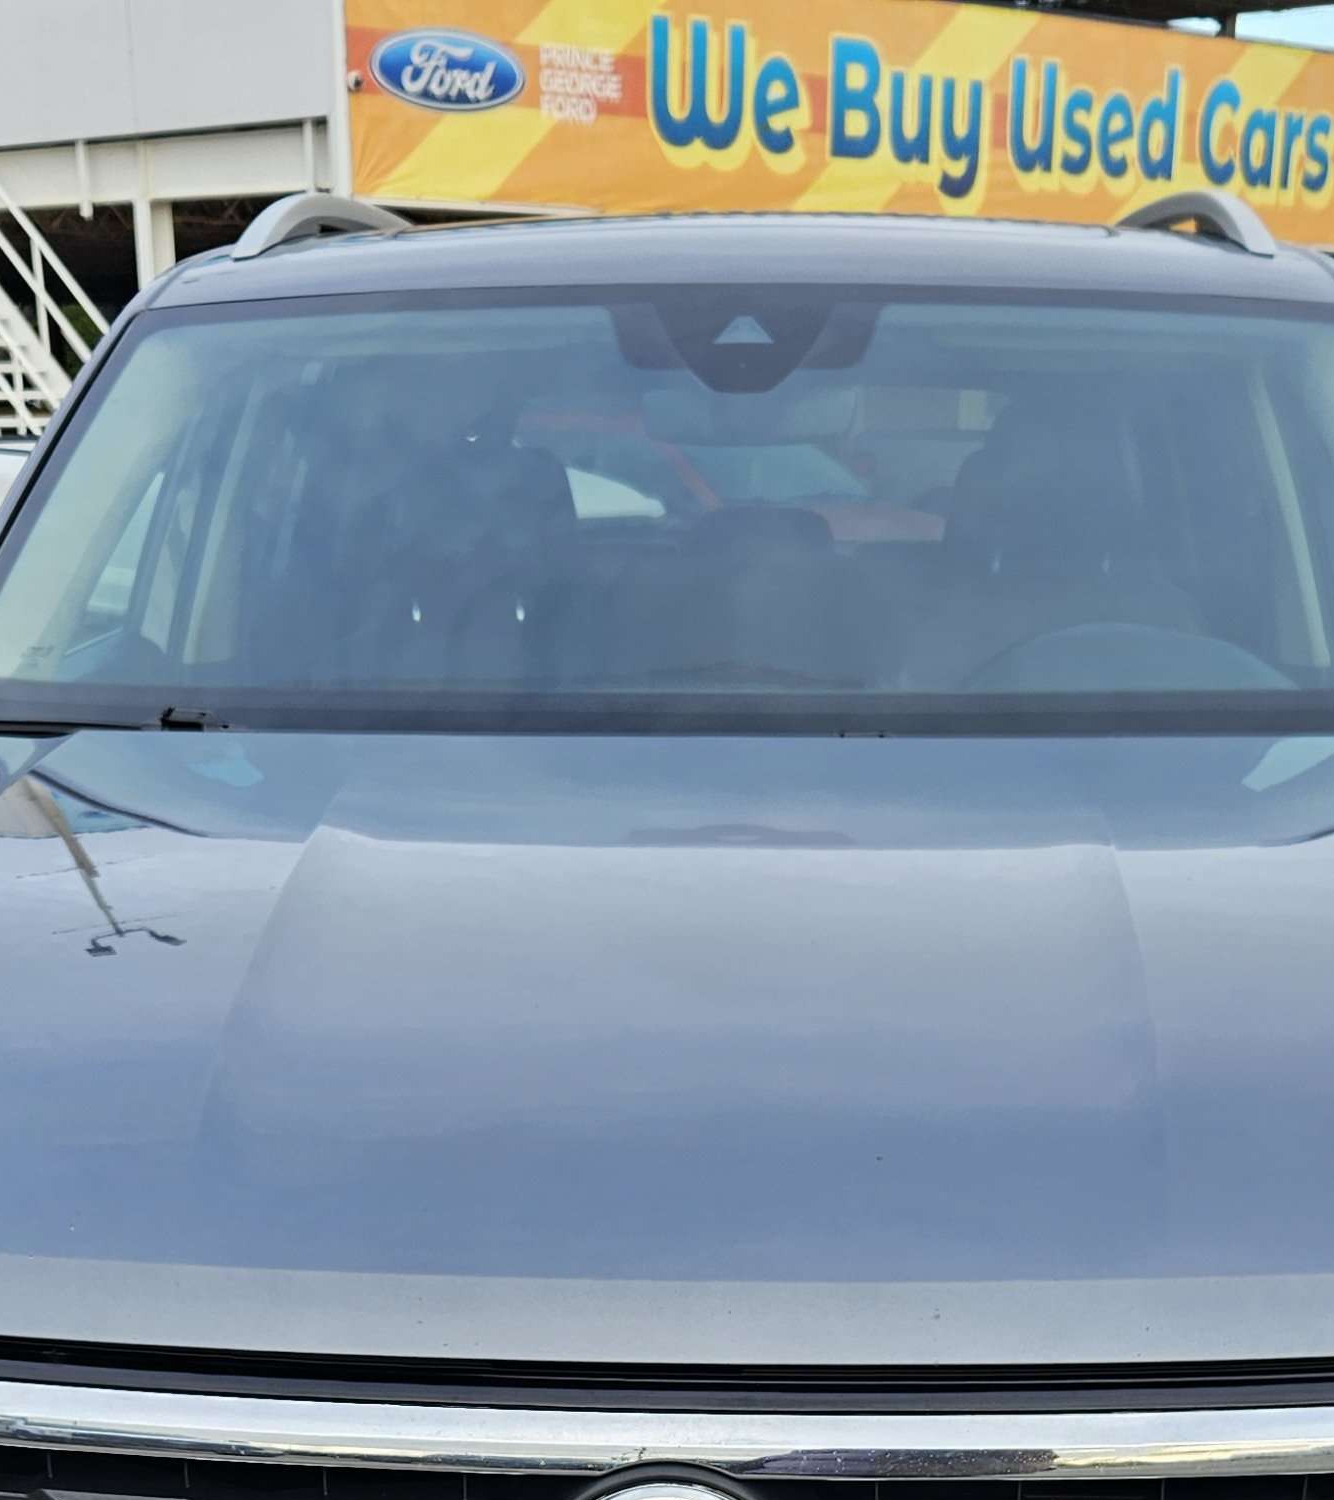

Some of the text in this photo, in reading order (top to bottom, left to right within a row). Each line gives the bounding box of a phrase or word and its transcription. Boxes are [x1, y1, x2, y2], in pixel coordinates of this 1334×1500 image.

[401, 39, 498, 102] Ford
[539, 43, 615, 71] PRINCE
[539, 69, 622, 102] GEORGE
[539, 95, 597, 125] FORD
[650, 14, 800, 154] We
[830, 36, 983, 199] Buy
[1008, 57, 1182, 182] Used
[1199, 79, 1332, 193] Cars
